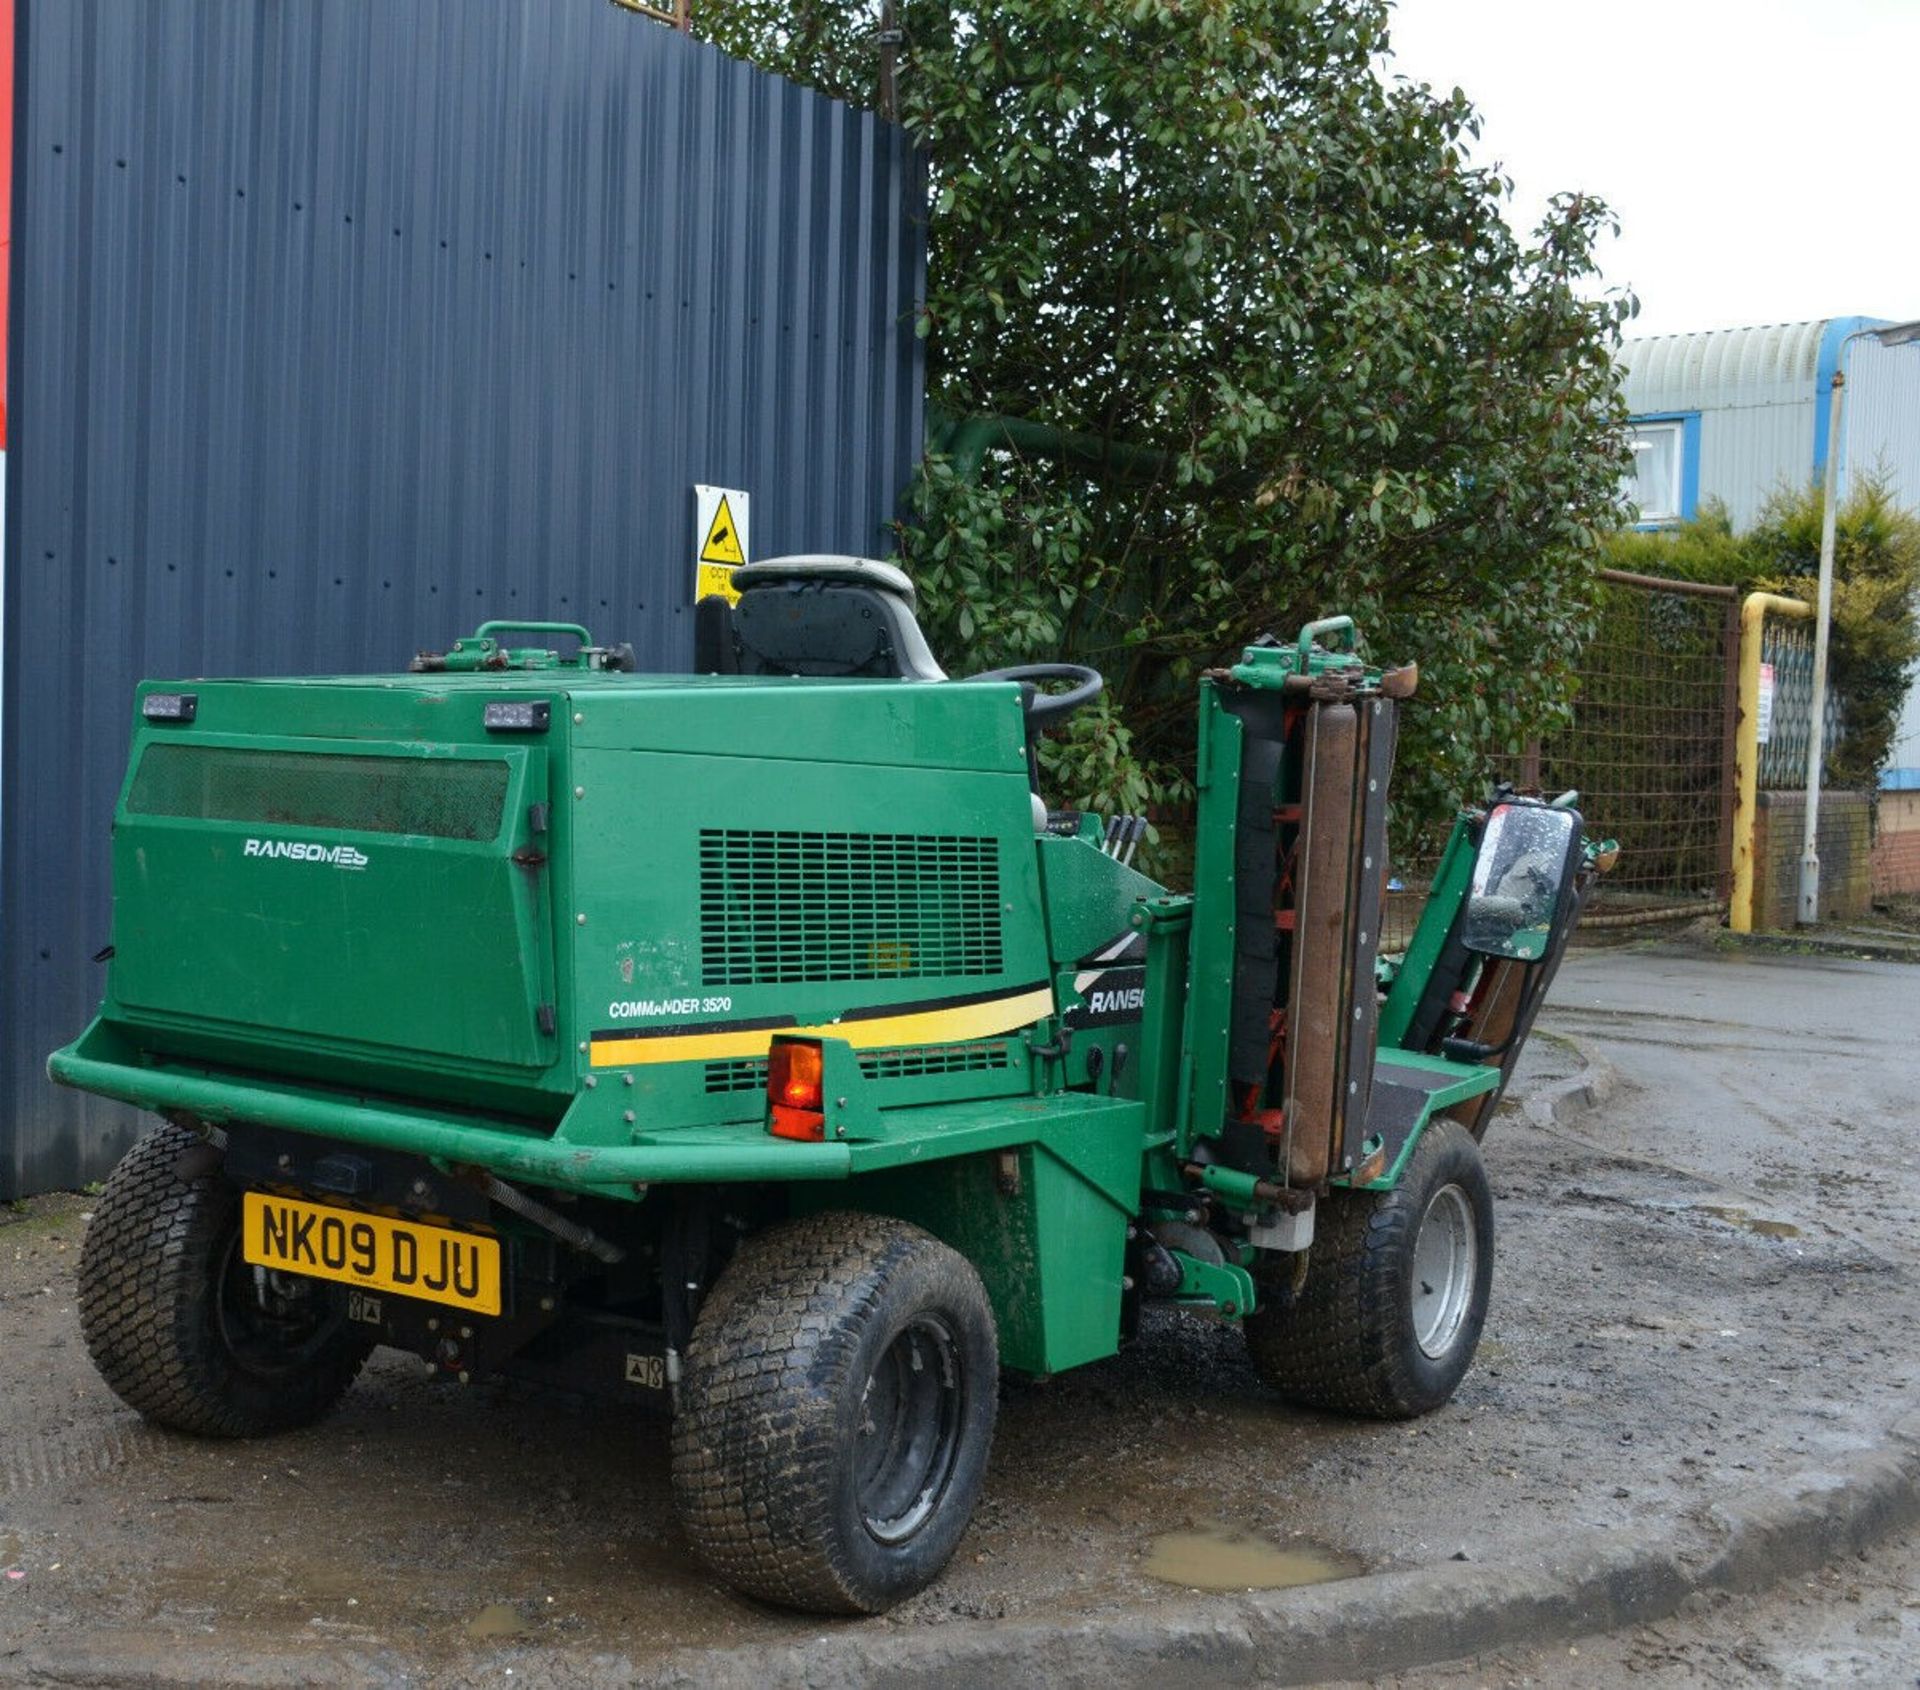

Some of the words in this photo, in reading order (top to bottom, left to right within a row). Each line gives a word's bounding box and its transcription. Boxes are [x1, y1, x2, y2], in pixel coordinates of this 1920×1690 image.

[243, 839, 369, 866] RANSOMES
[263, 1204, 376, 1276] NK09
[391, 1229, 479, 1299] DJU
